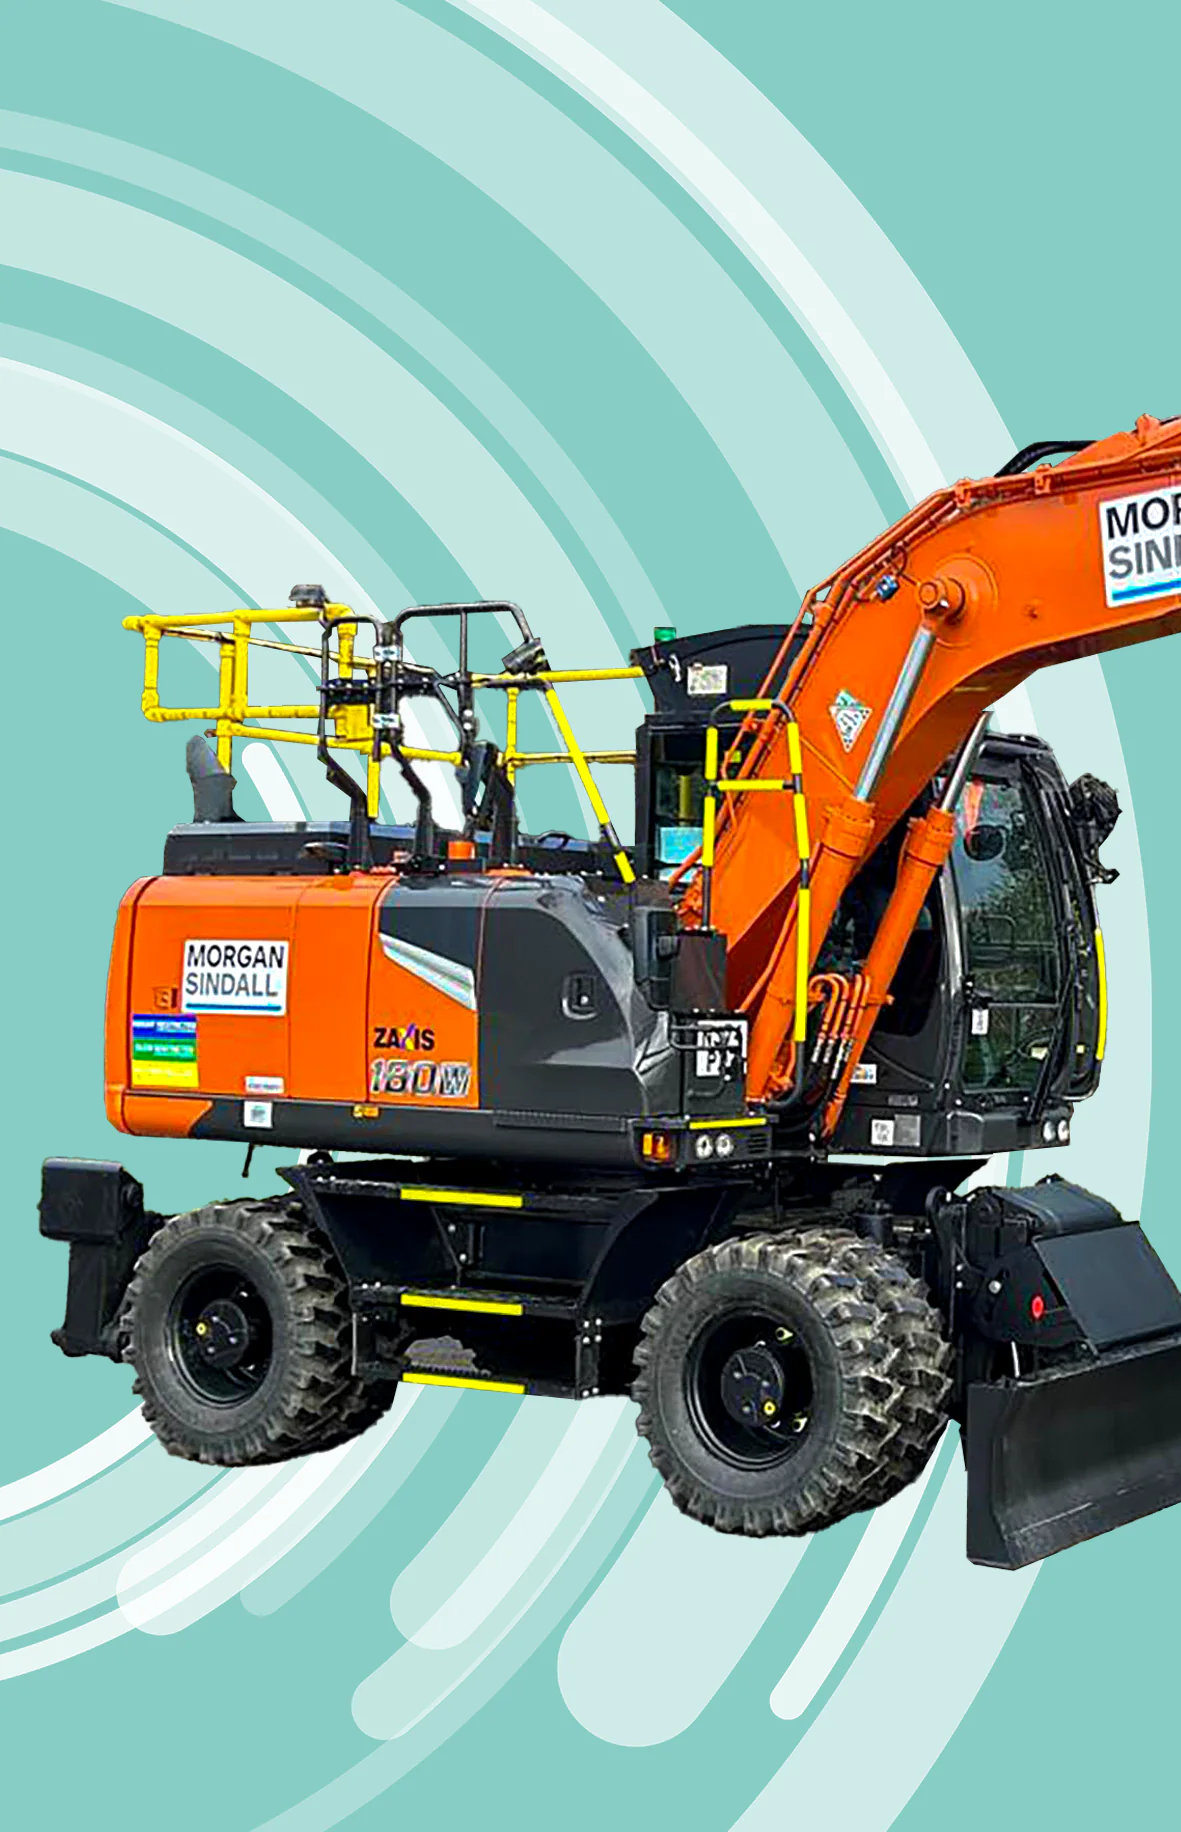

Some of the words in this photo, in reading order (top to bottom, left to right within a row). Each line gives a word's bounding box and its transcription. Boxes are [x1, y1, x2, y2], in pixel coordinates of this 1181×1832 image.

[187, 944, 285, 968] MORGAN
[185, 972, 278, 997] SINDALL
[373, 1022, 435, 1051] ZAXIS
